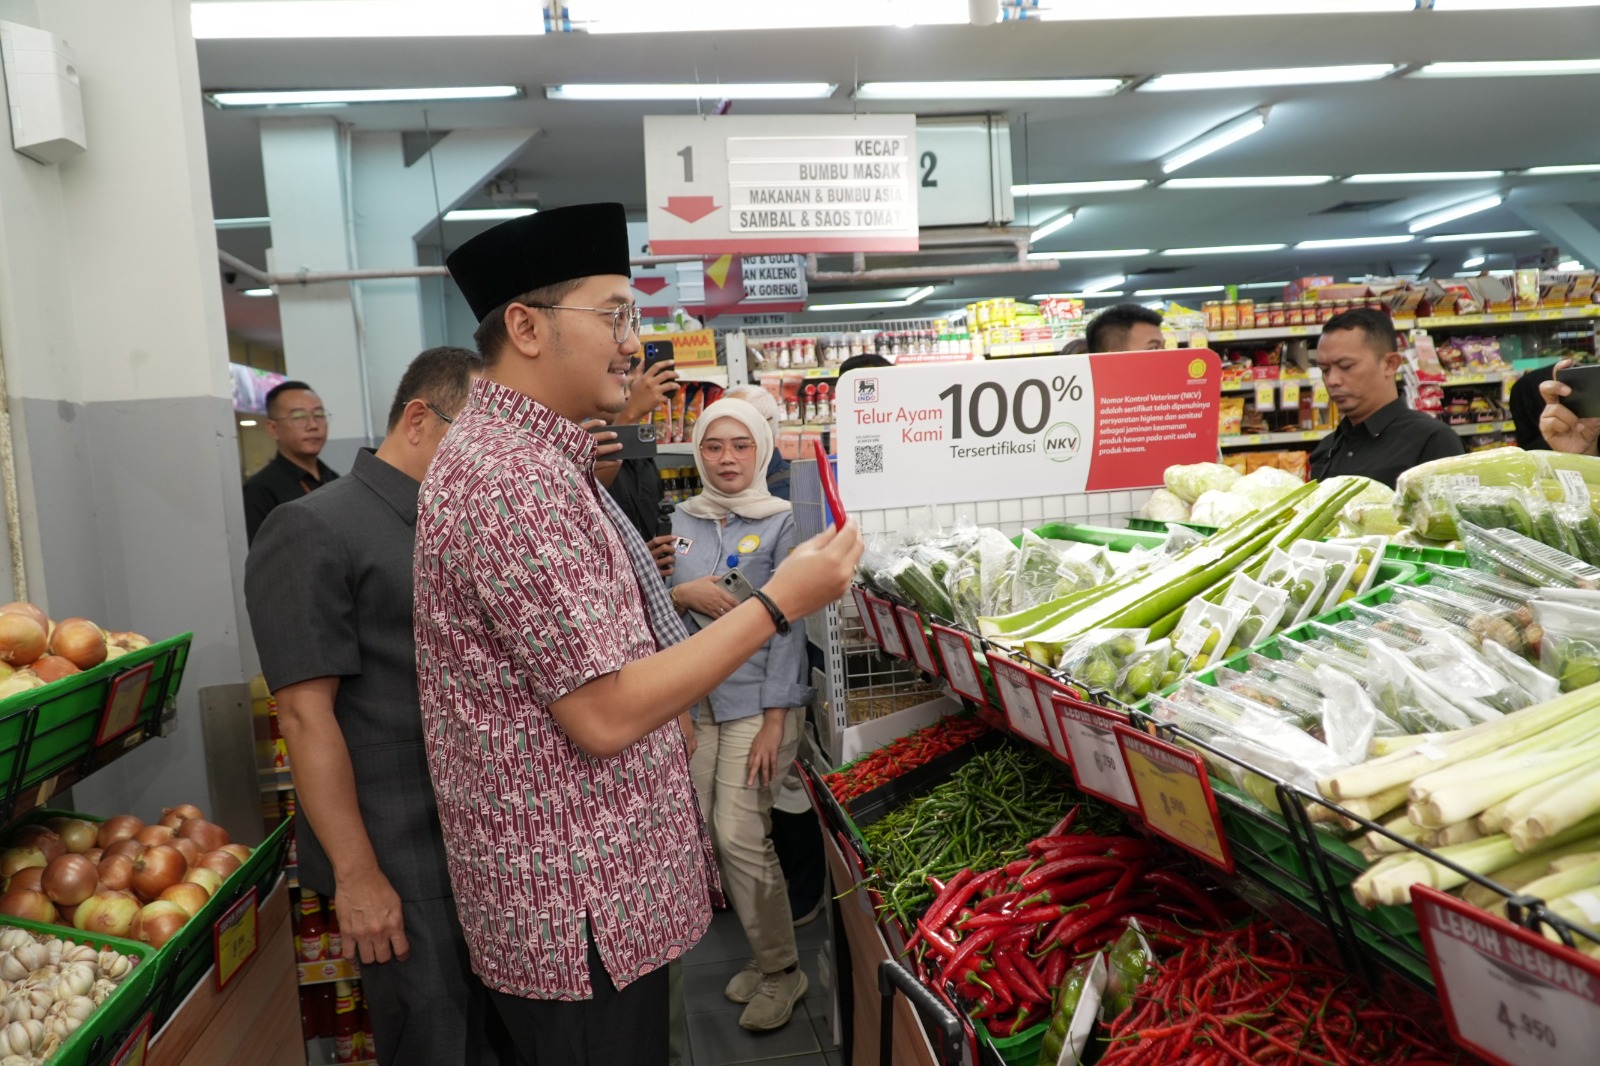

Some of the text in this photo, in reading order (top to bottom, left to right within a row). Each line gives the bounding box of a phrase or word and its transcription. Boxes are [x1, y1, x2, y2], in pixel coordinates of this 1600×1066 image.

[855, 140, 900, 156] KECAP
[677, 146, 694, 182] 1
[800, 163, 901, 180] BUMBU MASAK
[920, 150, 938, 188] 2
[750, 189, 810, 204] MAKANAN
[816, 188, 823, 203] &
[828, 188, 871, 202] BUMBU
[740, 210, 901, 228] SAMBAL & SAOS TOMAT
[760, 268, 796, 280] KALENG
[759, 284, 798, 296] GORENG
[672, 334, 710, 348] MAMA
[1124, 394, 1150, 403] Kontrol
[1150, 393, 1180, 402] Veteriner
[1180, 391, 1202, 400] (NKV)
[1100, 406, 1122, 414] adalah
[1124, 405, 1152, 413] sertifikat
[1172, 401, 1210, 411] dipenuhinya
[854, 406, 942, 426] Telur Ayam
[1100, 416, 1140, 426] persyaratan
[1140, 414, 1164, 424] higiene
[1178, 411, 1202, 419] sanitasi
[902, 427, 942, 443] Kami
[1100, 423, 1187, 436] sebagai jaminan keamanan
[1047, 437, 1078, 450] NKV
[1100, 436, 1122, 446] produk
[1146, 434, 1162, 442] pada
[1177, 432, 1196, 440] usaha
[950, 440, 1036, 458] Tersertifikasi
[1099, 446, 1122, 456] produk
[1434, 904, 1503, 956] LEBIH
[1506, 936, 1595, 999] SEGAR
